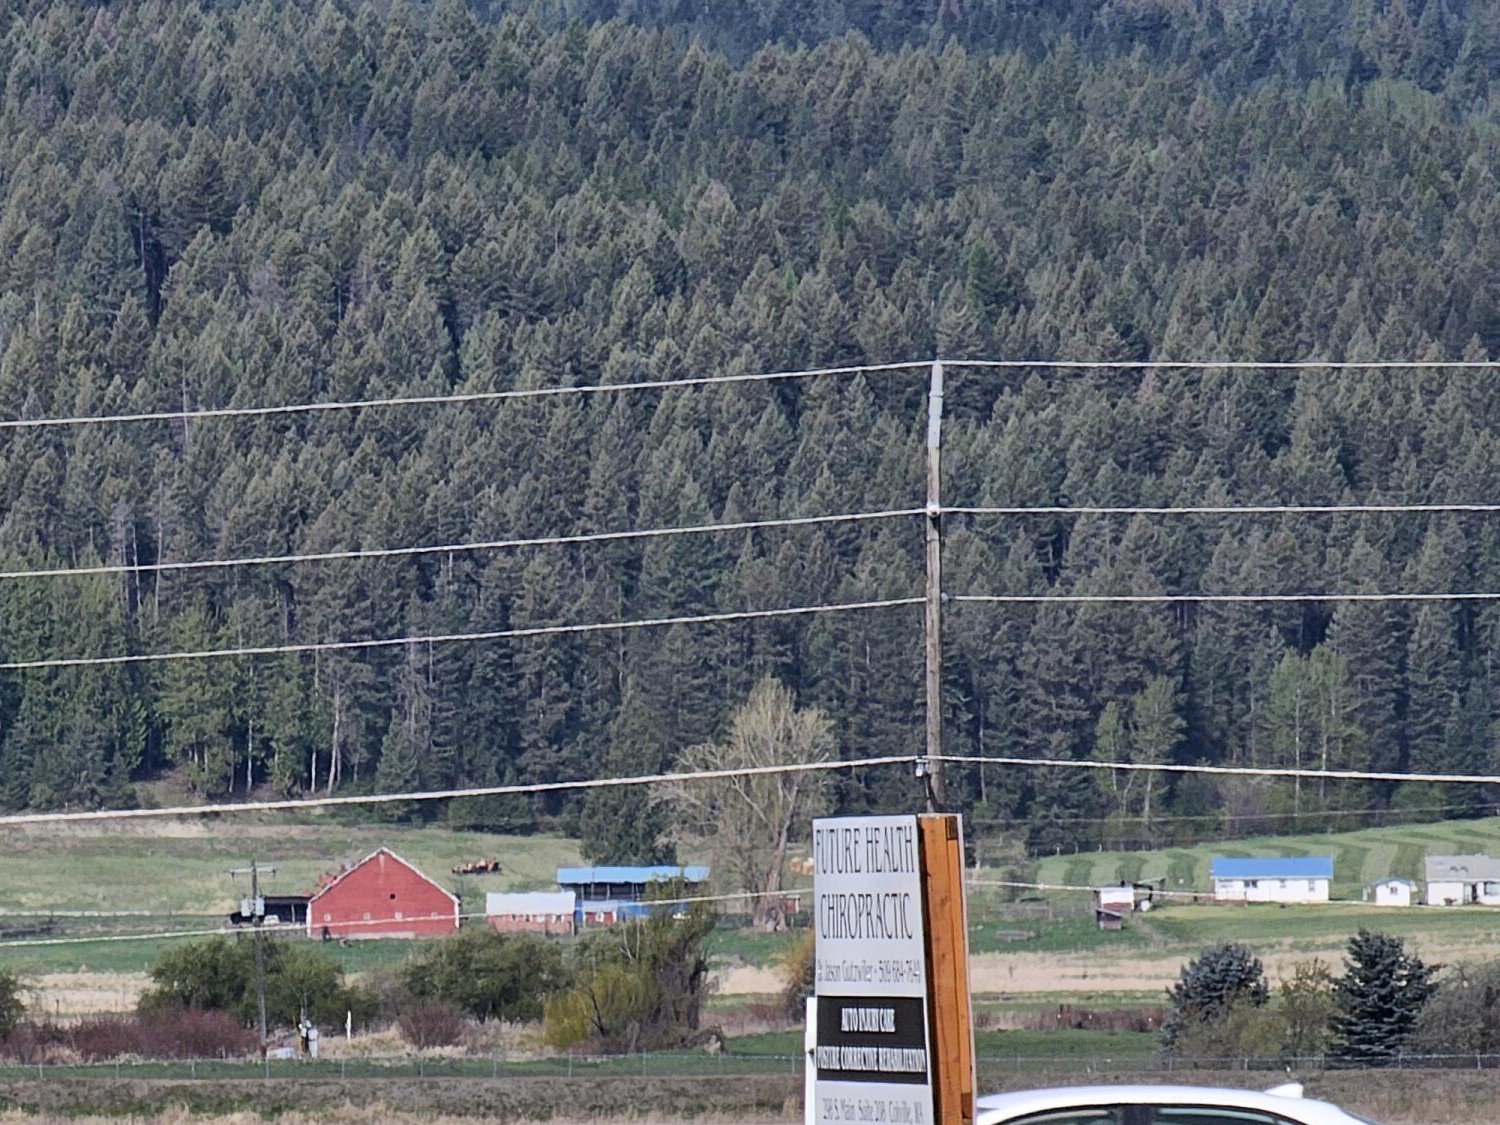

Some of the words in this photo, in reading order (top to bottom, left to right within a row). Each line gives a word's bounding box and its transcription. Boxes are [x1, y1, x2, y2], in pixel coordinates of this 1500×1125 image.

[816, 827, 861, 874] FUTURE
[866, 826, 915, 874] HEALTH
[820, 893, 913, 940] CHIROPRACTIC
[841, 1007, 858, 1032] AUTO
[858, 1008, 879, 1032] INJURY
[879, 1008, 895, 1033] CARE
[840, 1097, 856, 1121] Main
